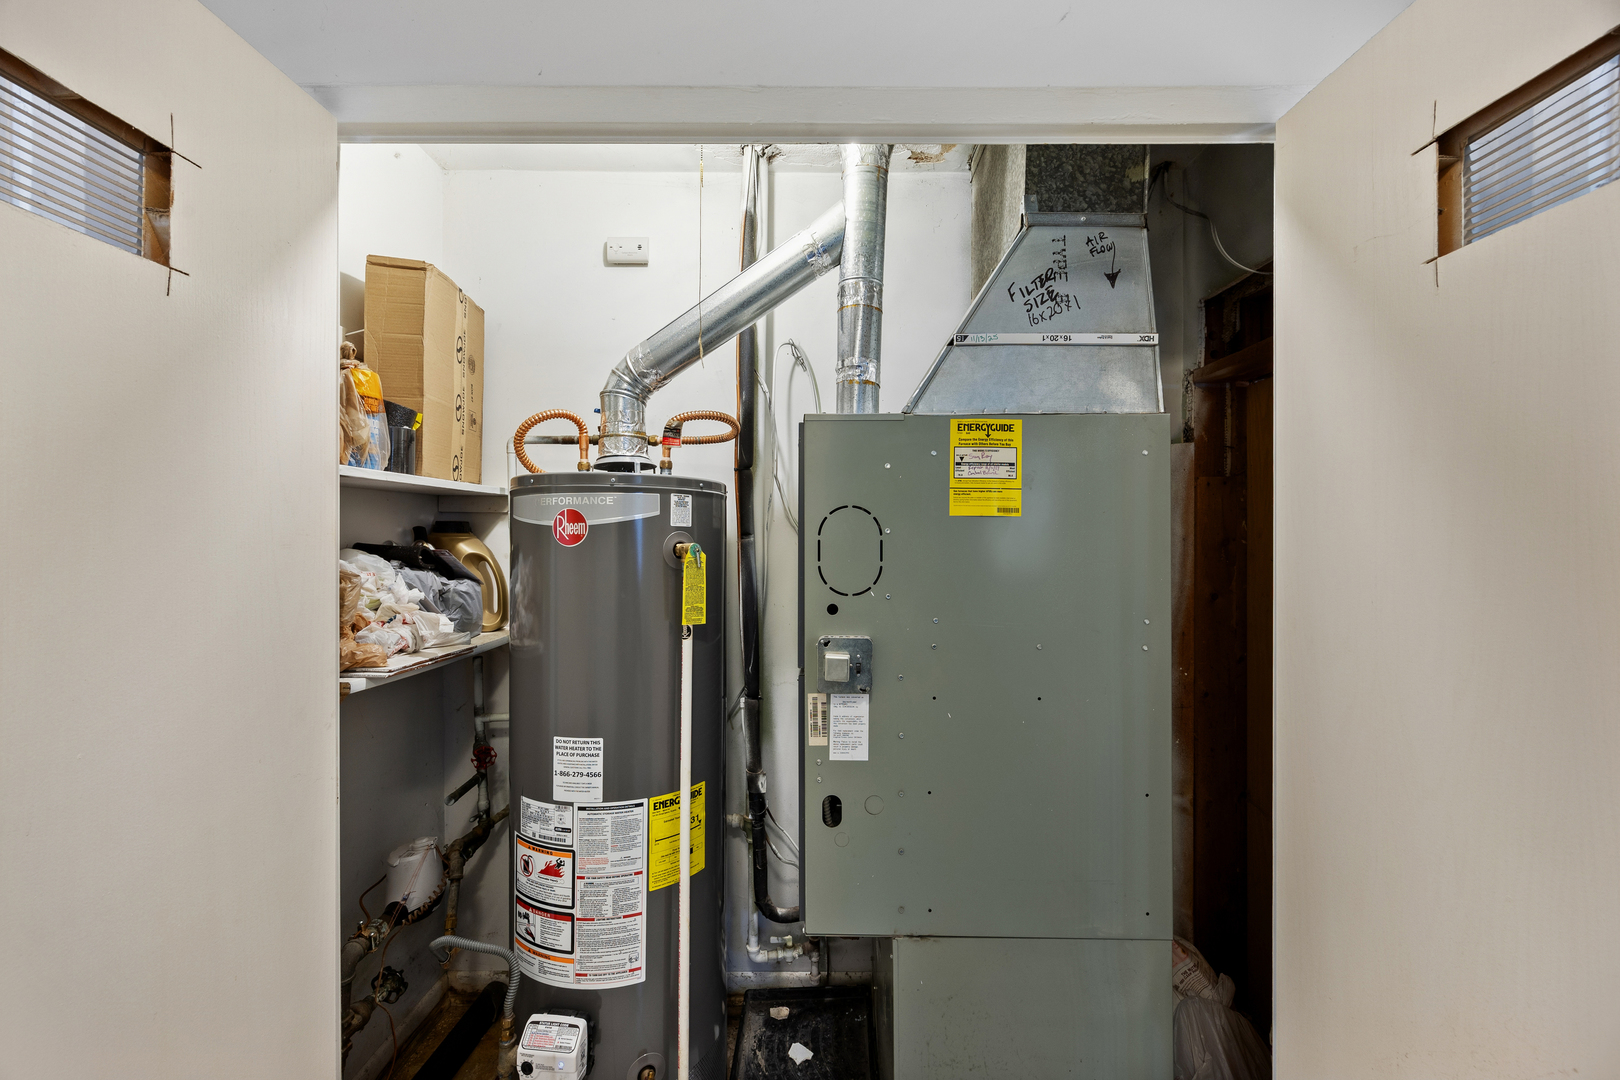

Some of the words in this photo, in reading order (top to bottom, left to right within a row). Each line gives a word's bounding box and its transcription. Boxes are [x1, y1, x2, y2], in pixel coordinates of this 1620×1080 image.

[1086, 231, 1108, 246] AIR
[1089, 243, 1113, 257] FLOW
[1008, 268, 1056, 302] FILTER
[1023, 285, 1059, 312] SIZE
[957, 423, 1015, 432] ENERGYGUIDE
[536, 496, 614, 506] ERFORMANCE
[556, 509, 587, 541] Rheem
[555, 770, 601, 778] 1-866-279-4566
[532, 846, 553, 855] WARNING
[533, 910, 550, 918] DANGER
[533, 951, 550, 960] WARNING
